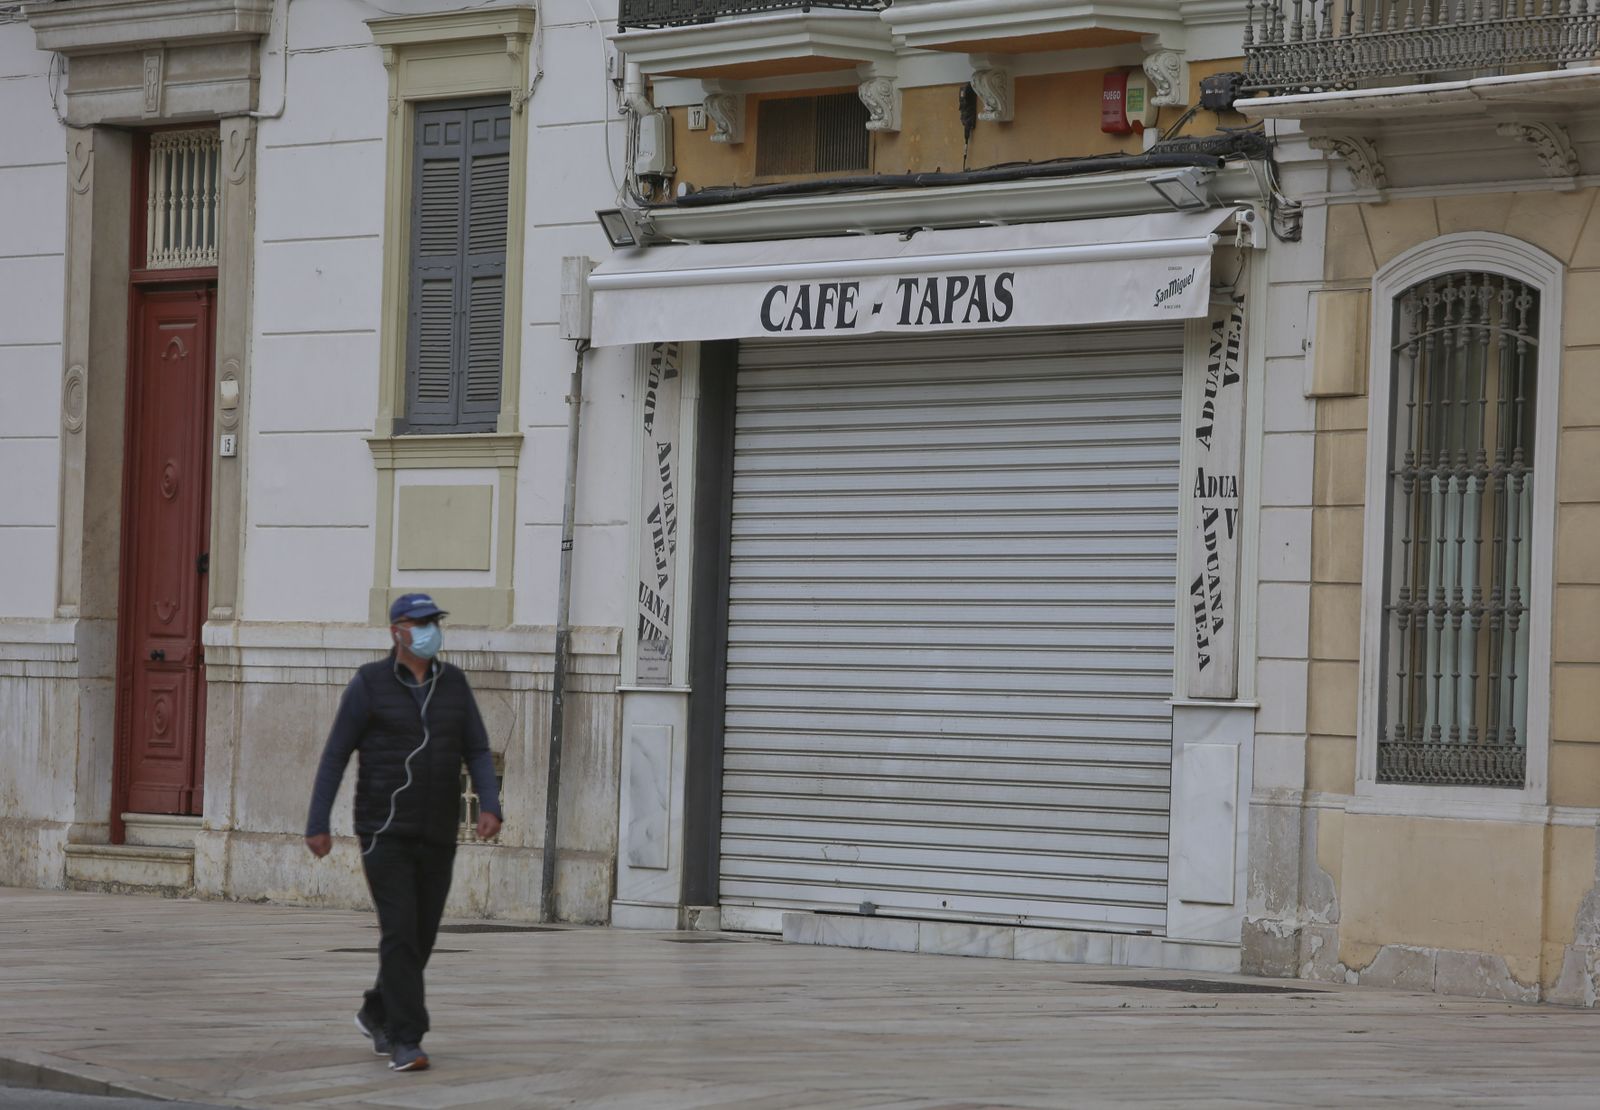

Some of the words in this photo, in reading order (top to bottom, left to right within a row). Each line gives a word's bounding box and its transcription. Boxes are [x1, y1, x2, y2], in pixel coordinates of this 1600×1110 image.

[693, 110, 701, 126] 17
[1103, 90, 1121, 100] FUEGO
[760, 281, 860, 332] CAFE
[896, 272, 1015, 326] TAPAS
[1223, 294, 1246, 388] VIEJA
[1195, 320, 1225, 451] ADUANA
[224, 438, 231, 452] 15
[1193, 467, 1239, 498] ADUA
[656, 441, 677, 556] ADUANA
[647, 502, 669, 591] VIEJA
[1201, 505, 1225, 635] ADUANA
[1190, 573, 1211, 672] VIEJA
